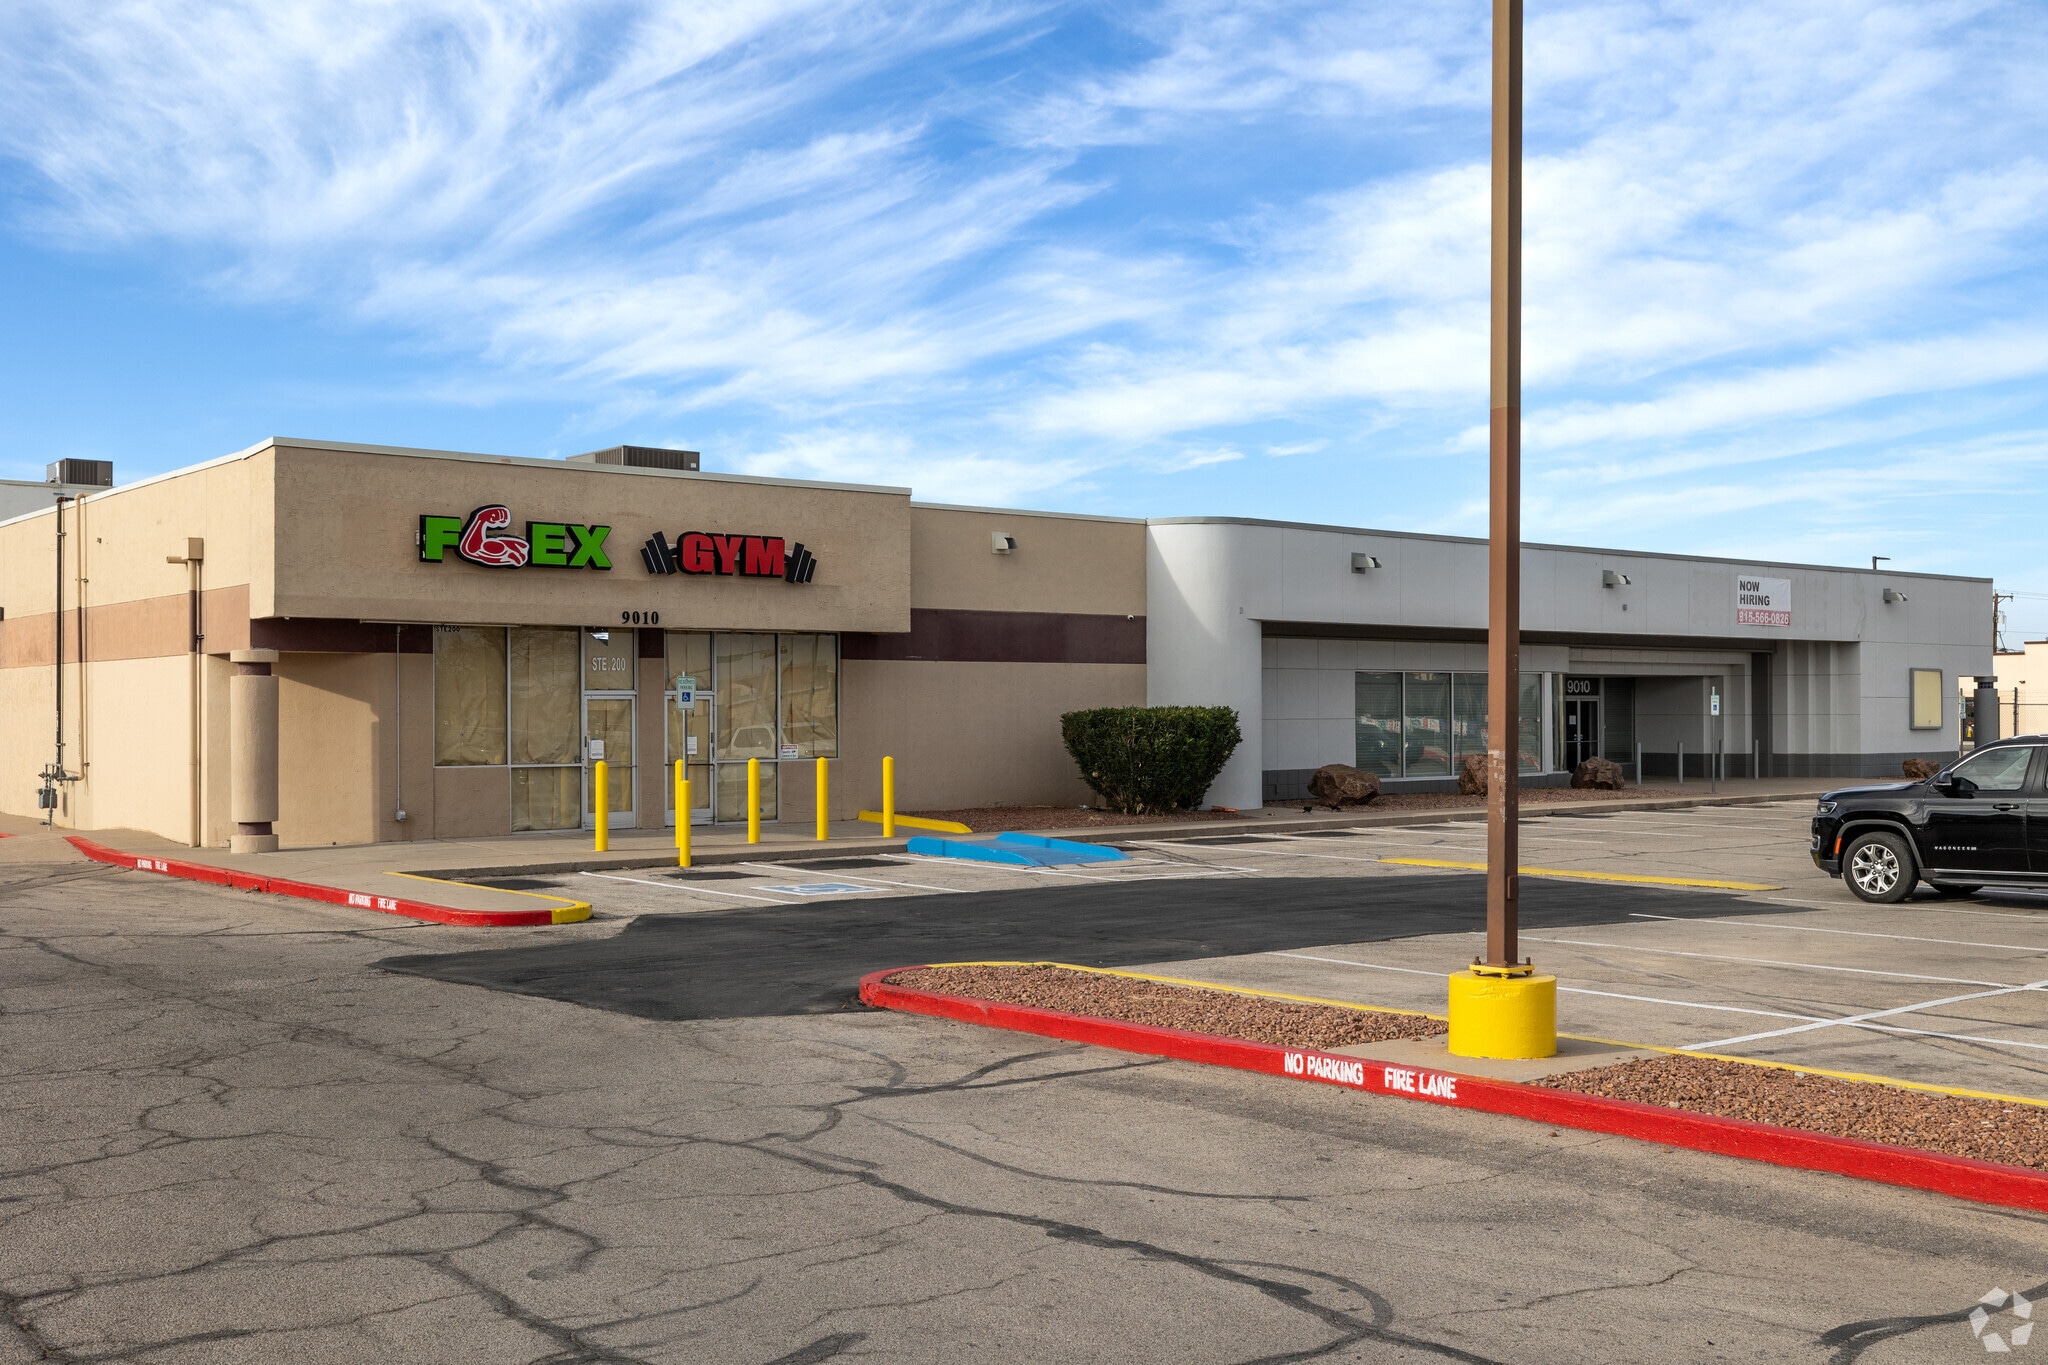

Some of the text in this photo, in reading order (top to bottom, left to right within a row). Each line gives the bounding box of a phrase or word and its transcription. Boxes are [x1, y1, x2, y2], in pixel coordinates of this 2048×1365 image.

[677, 531, 786, 578] GYM
[1739, 580, 1760, 592] NOW
[1739, 594, 1770, 606] HIRING
[621, 610, 660, 625] 9010
[592, 657, 626, 671] STE.200
[1567, 680, 1591, 693] 9010
[1284, 1051, 1458, 1100] NO PARKING FIRE LANE
